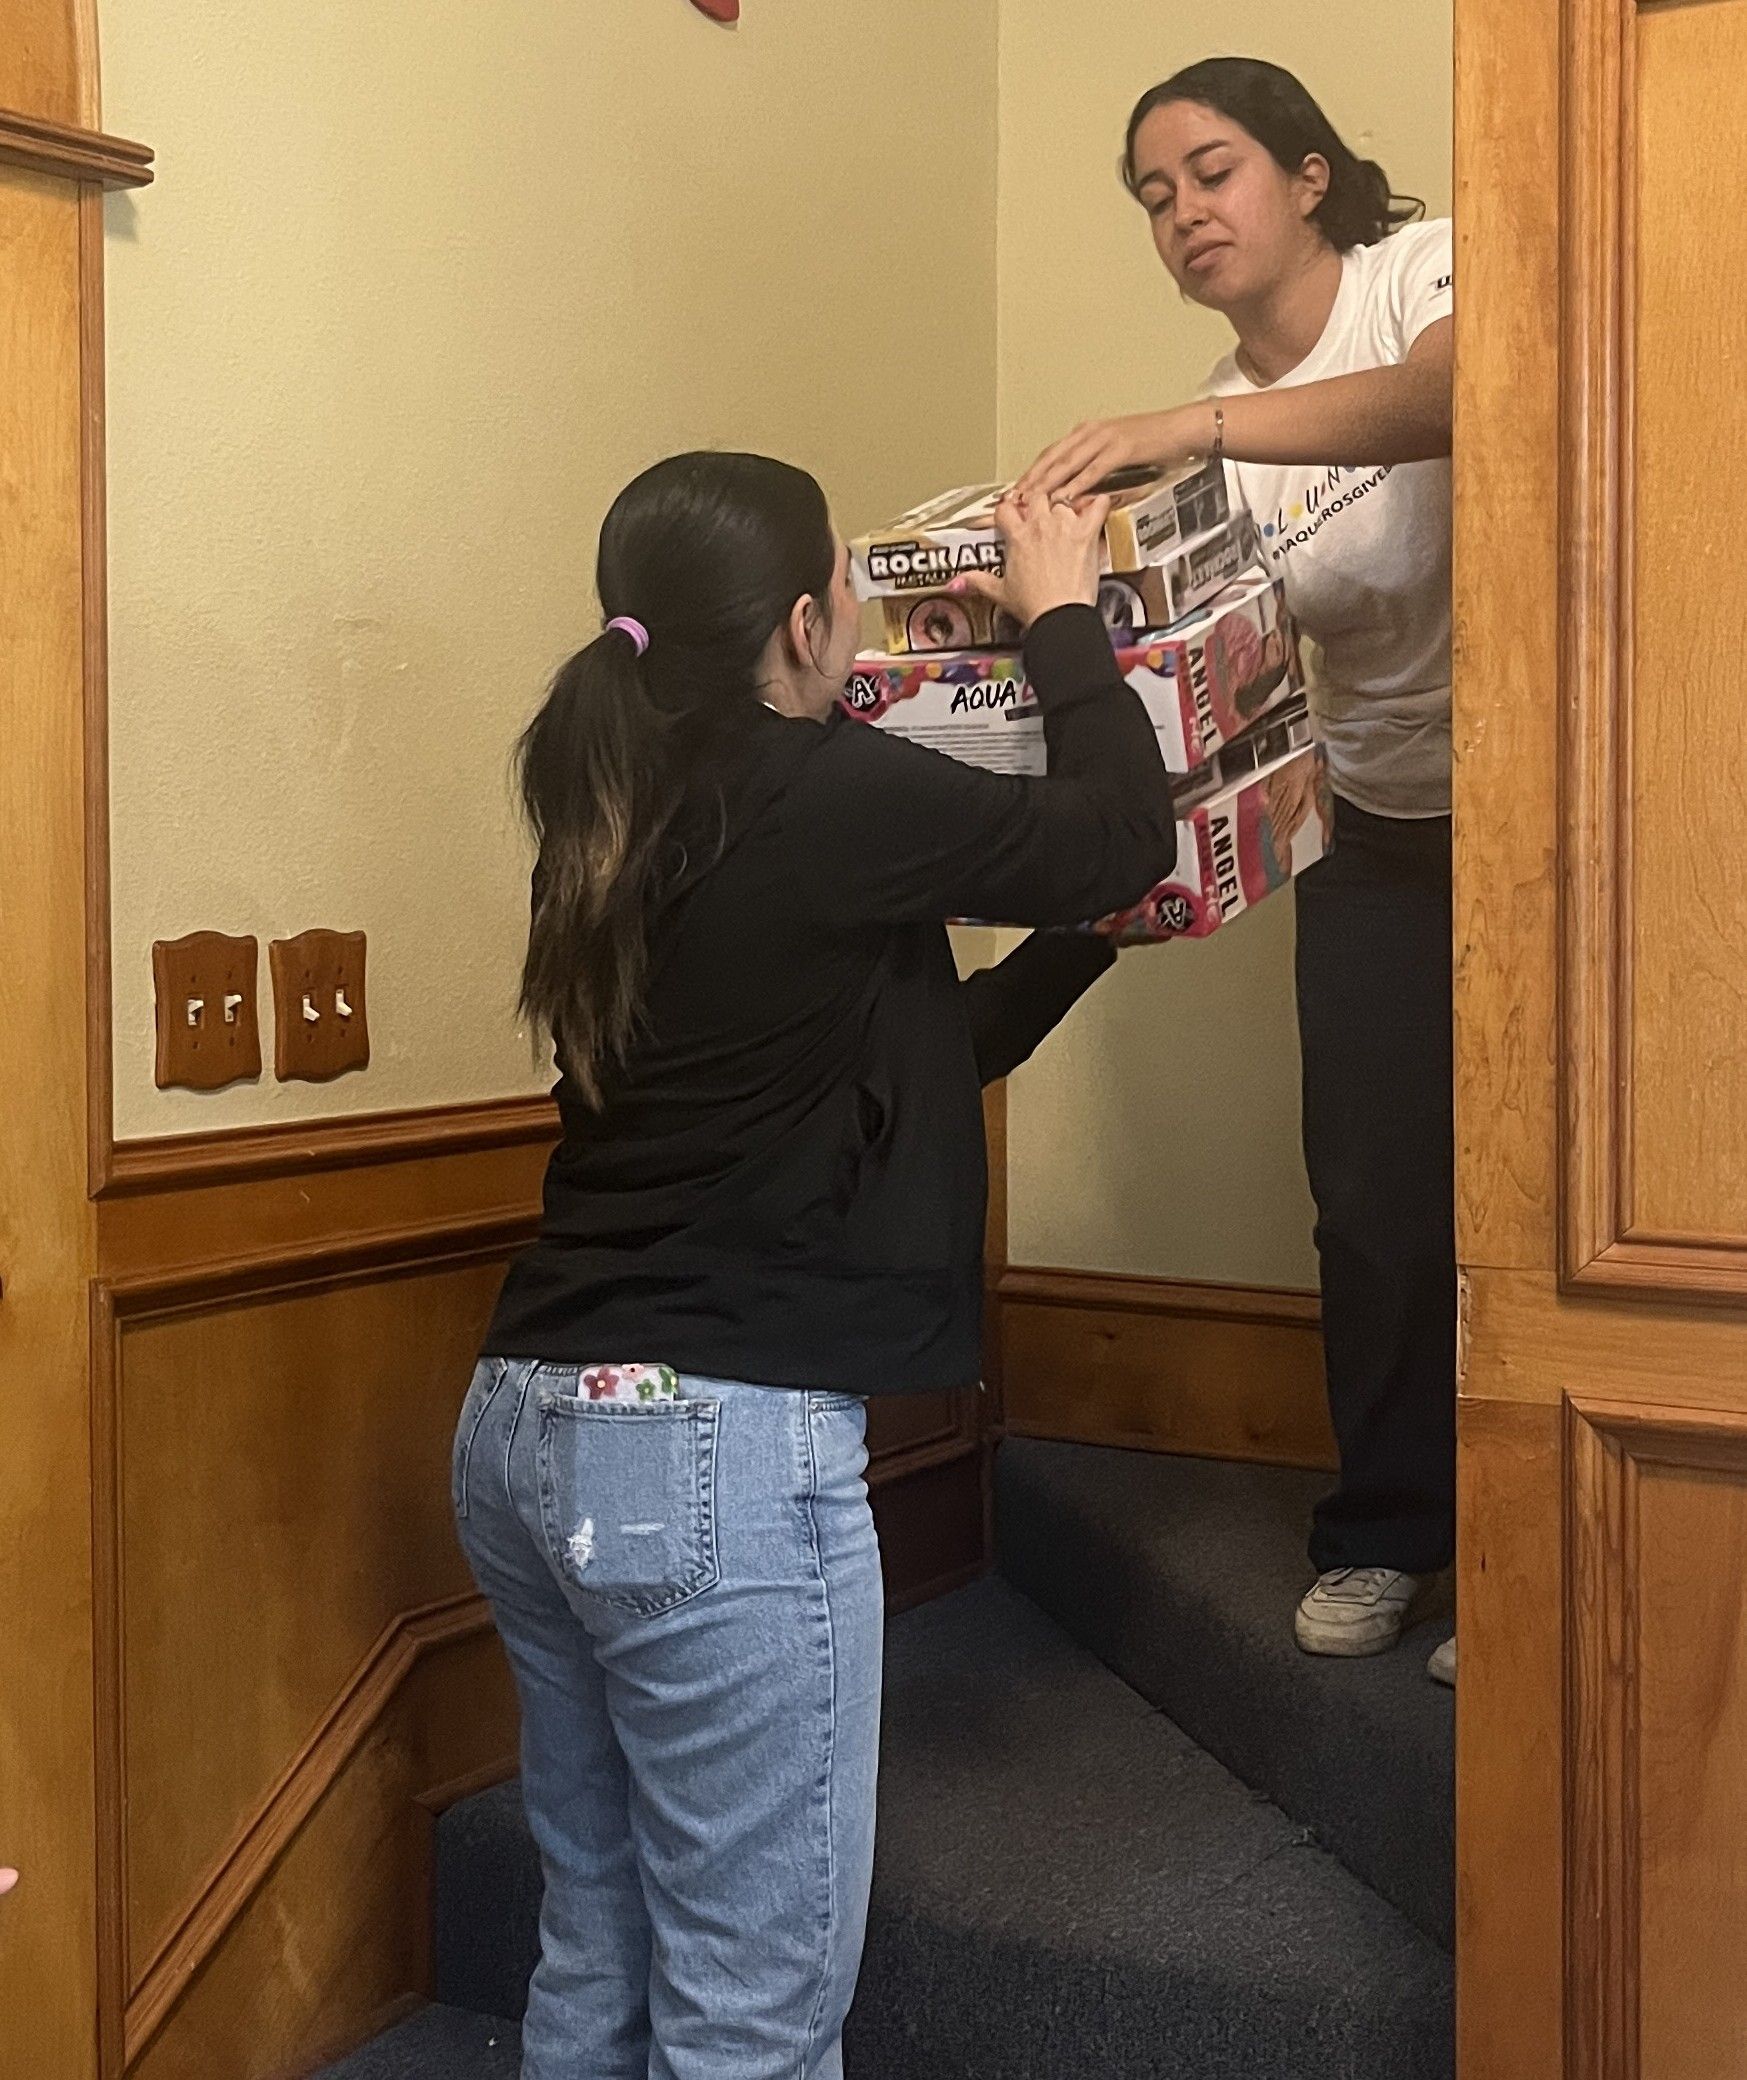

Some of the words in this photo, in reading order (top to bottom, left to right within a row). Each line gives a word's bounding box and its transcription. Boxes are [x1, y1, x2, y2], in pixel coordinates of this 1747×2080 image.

[870, 549, 956, 577] ROCK
[957, 542, 1005, 567] AR
[951, 680, 1017, 714] AQUA
[1188, 647, 1217, 753] ANGEL
[1210, 816, 1239, 918] ANGEL
